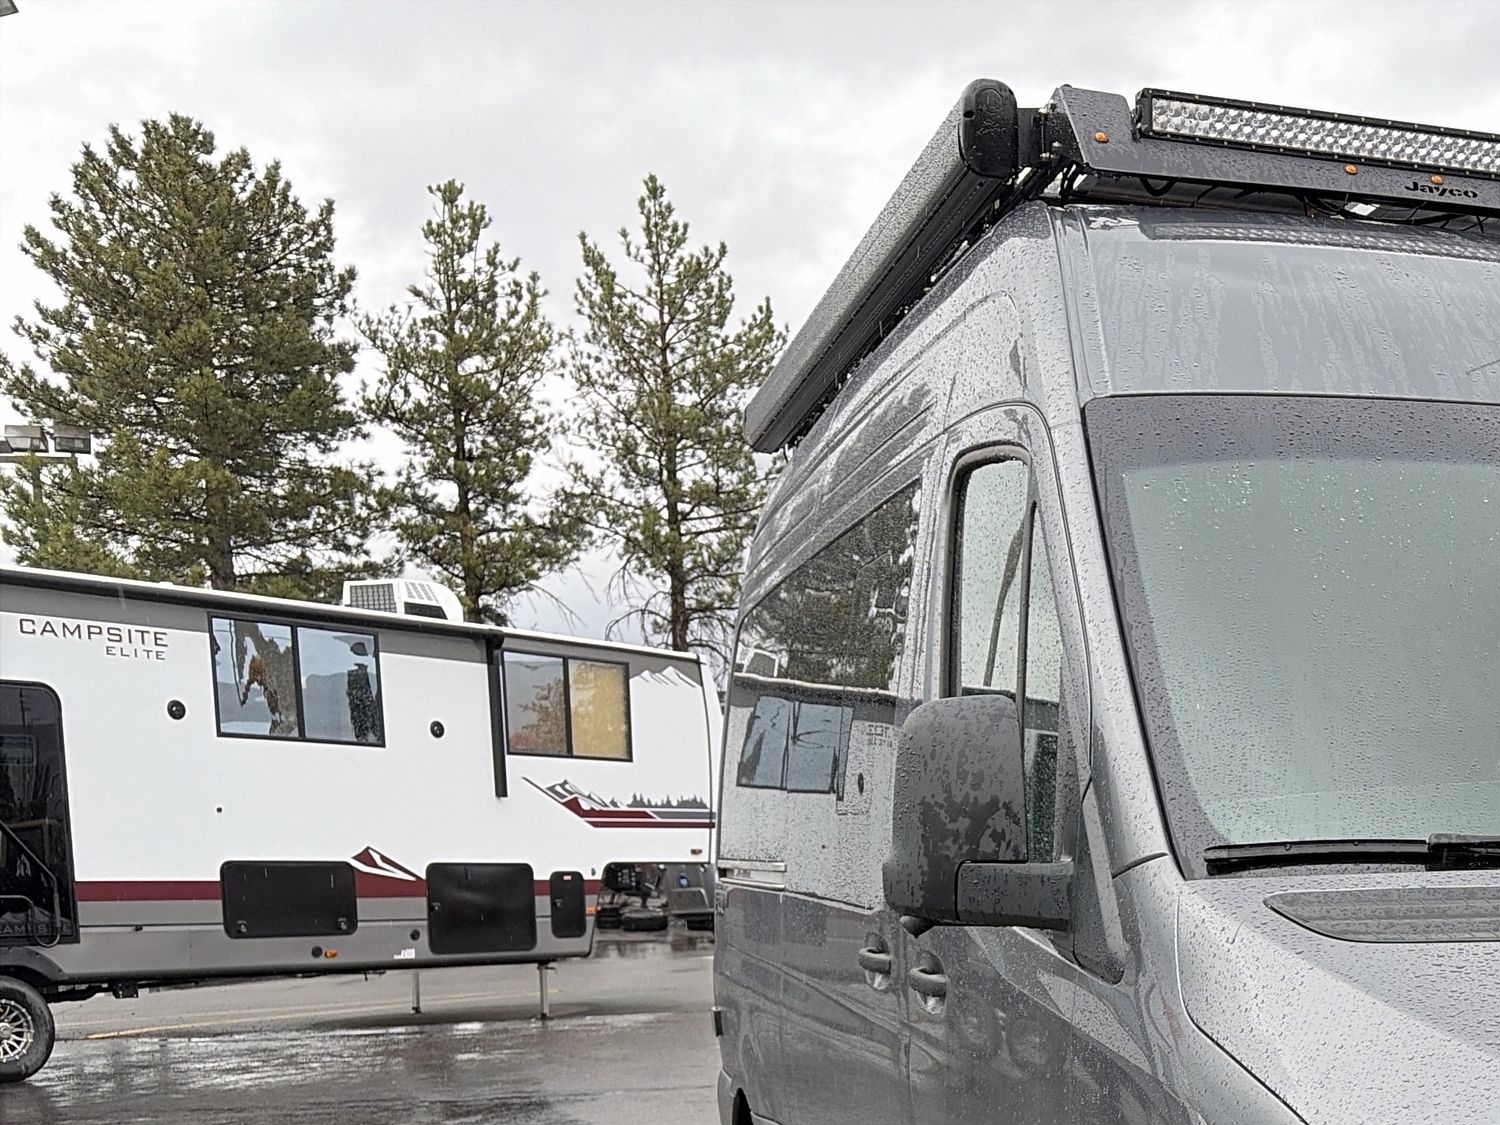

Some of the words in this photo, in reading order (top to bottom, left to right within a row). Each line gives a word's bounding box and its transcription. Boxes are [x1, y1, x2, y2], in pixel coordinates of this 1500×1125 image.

[1404, 181, 1478, 199] Jayco
[19, 618, 169, 648] CAMPSITE
[105, 645, 166, 661] ELITE
